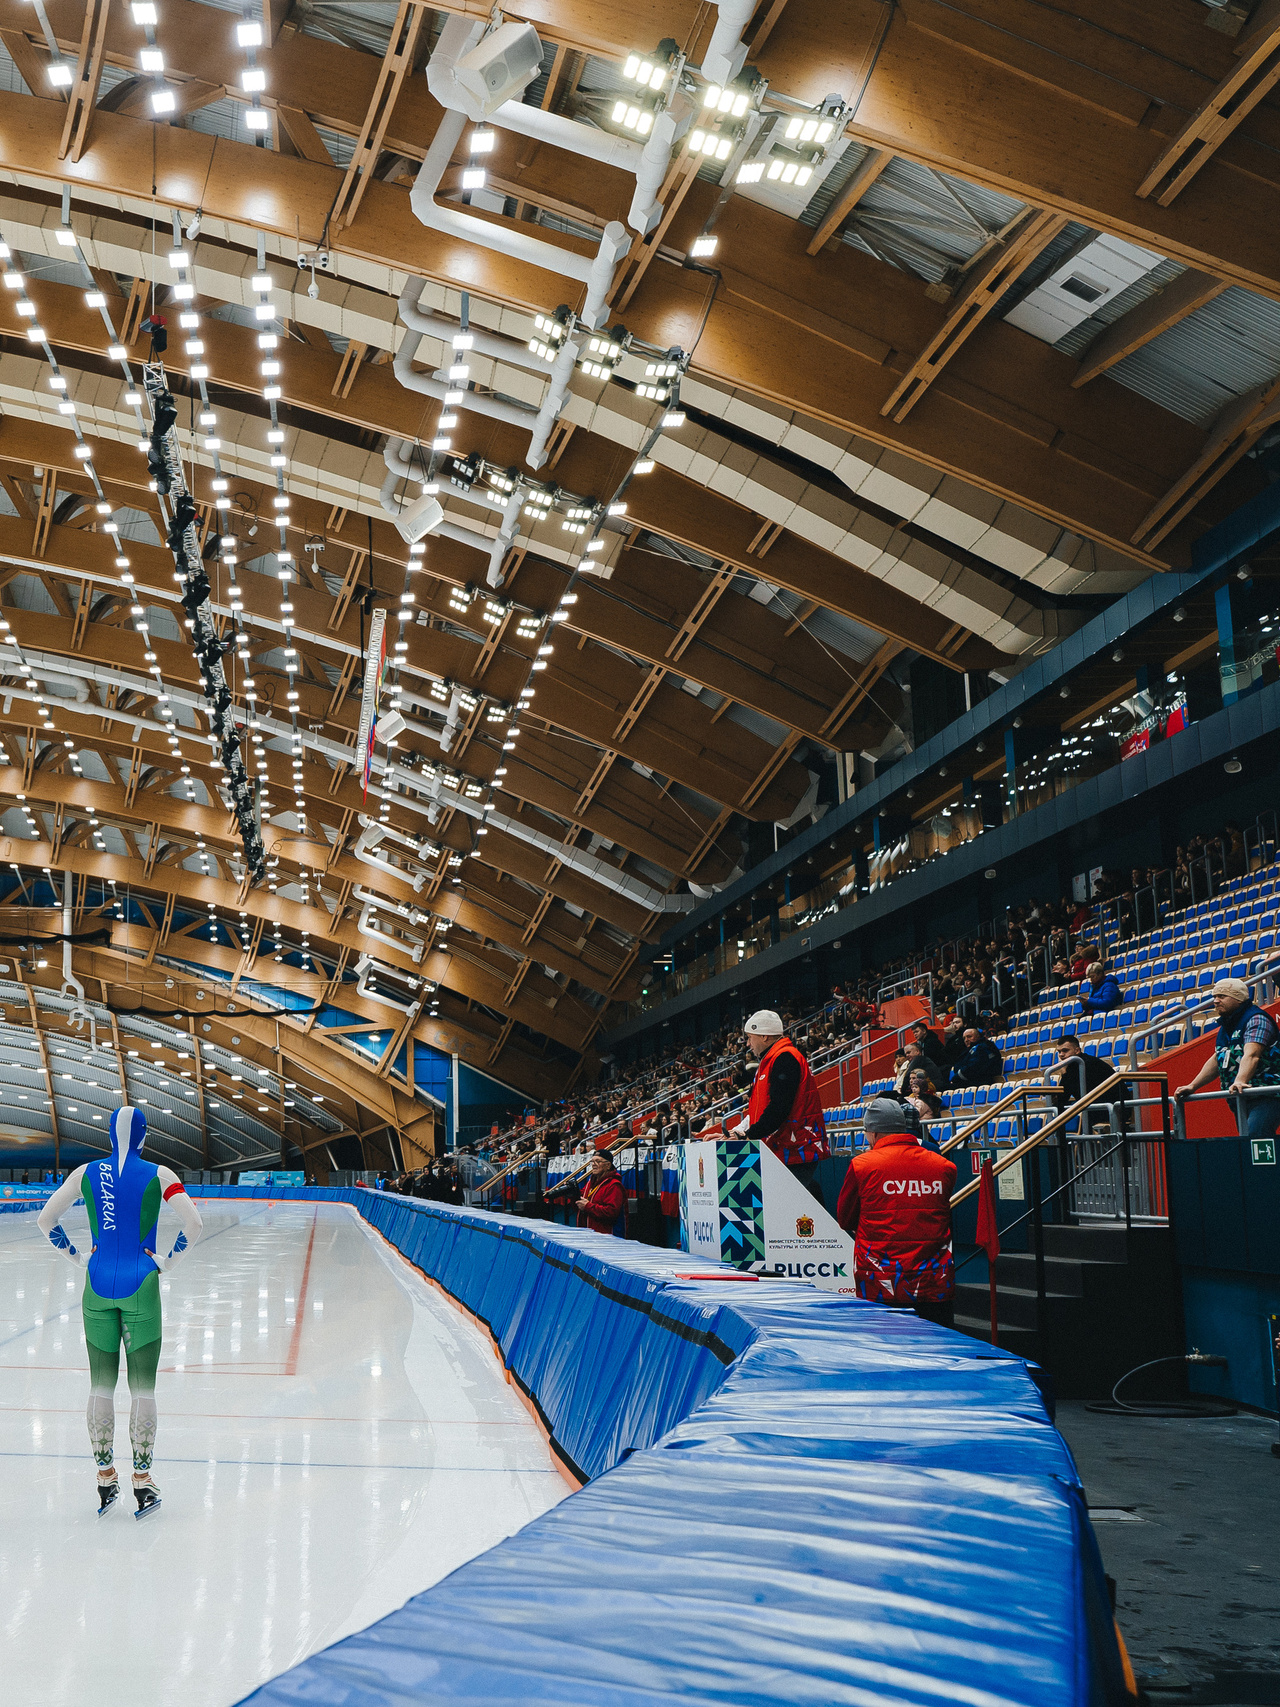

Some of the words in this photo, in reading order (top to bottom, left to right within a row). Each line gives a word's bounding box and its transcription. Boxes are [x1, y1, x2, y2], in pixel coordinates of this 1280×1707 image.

[98, 1162, 116, 1231] BELARUS
[882, 1180, 943, 1197] СУДЬЯ
[693, 1221, 715, 1245] РЦССК
[774, 1262, 848, 1278] РЦССК
